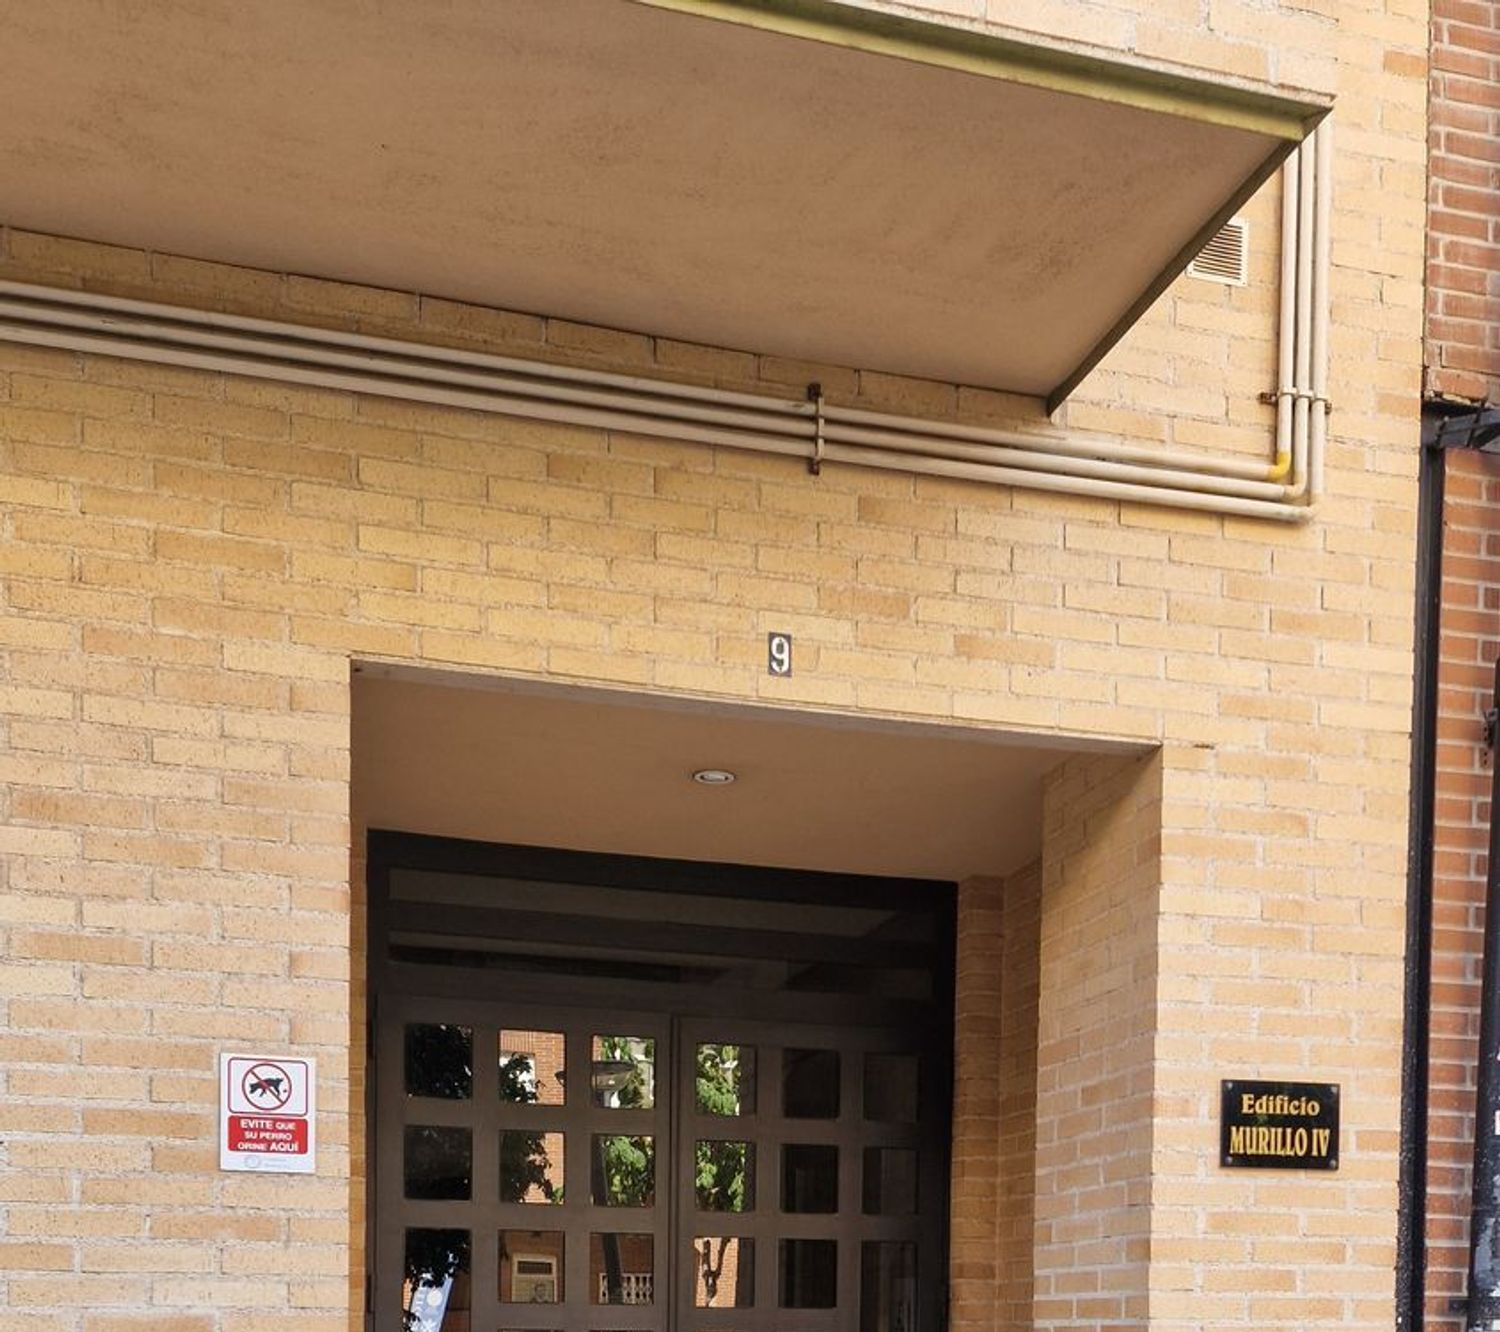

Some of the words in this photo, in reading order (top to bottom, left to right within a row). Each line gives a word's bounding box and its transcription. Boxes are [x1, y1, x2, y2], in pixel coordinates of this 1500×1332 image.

[771, 636, 789, 673] 9
[1242, 1093, 1320, 1116] Edificio
[241, 1119, 274, 1129] EVITE
[275, 1121, 296, 1130] QUE
[244, 1131, 258, 1139] SU
[259, 1132, 292, 1141] PERRO
[1230, 1126, 1308, 1157] MURILLO
[1311, 1128, 1330, 1157] IV
[237, 1141, 268, 1151] ORINE
